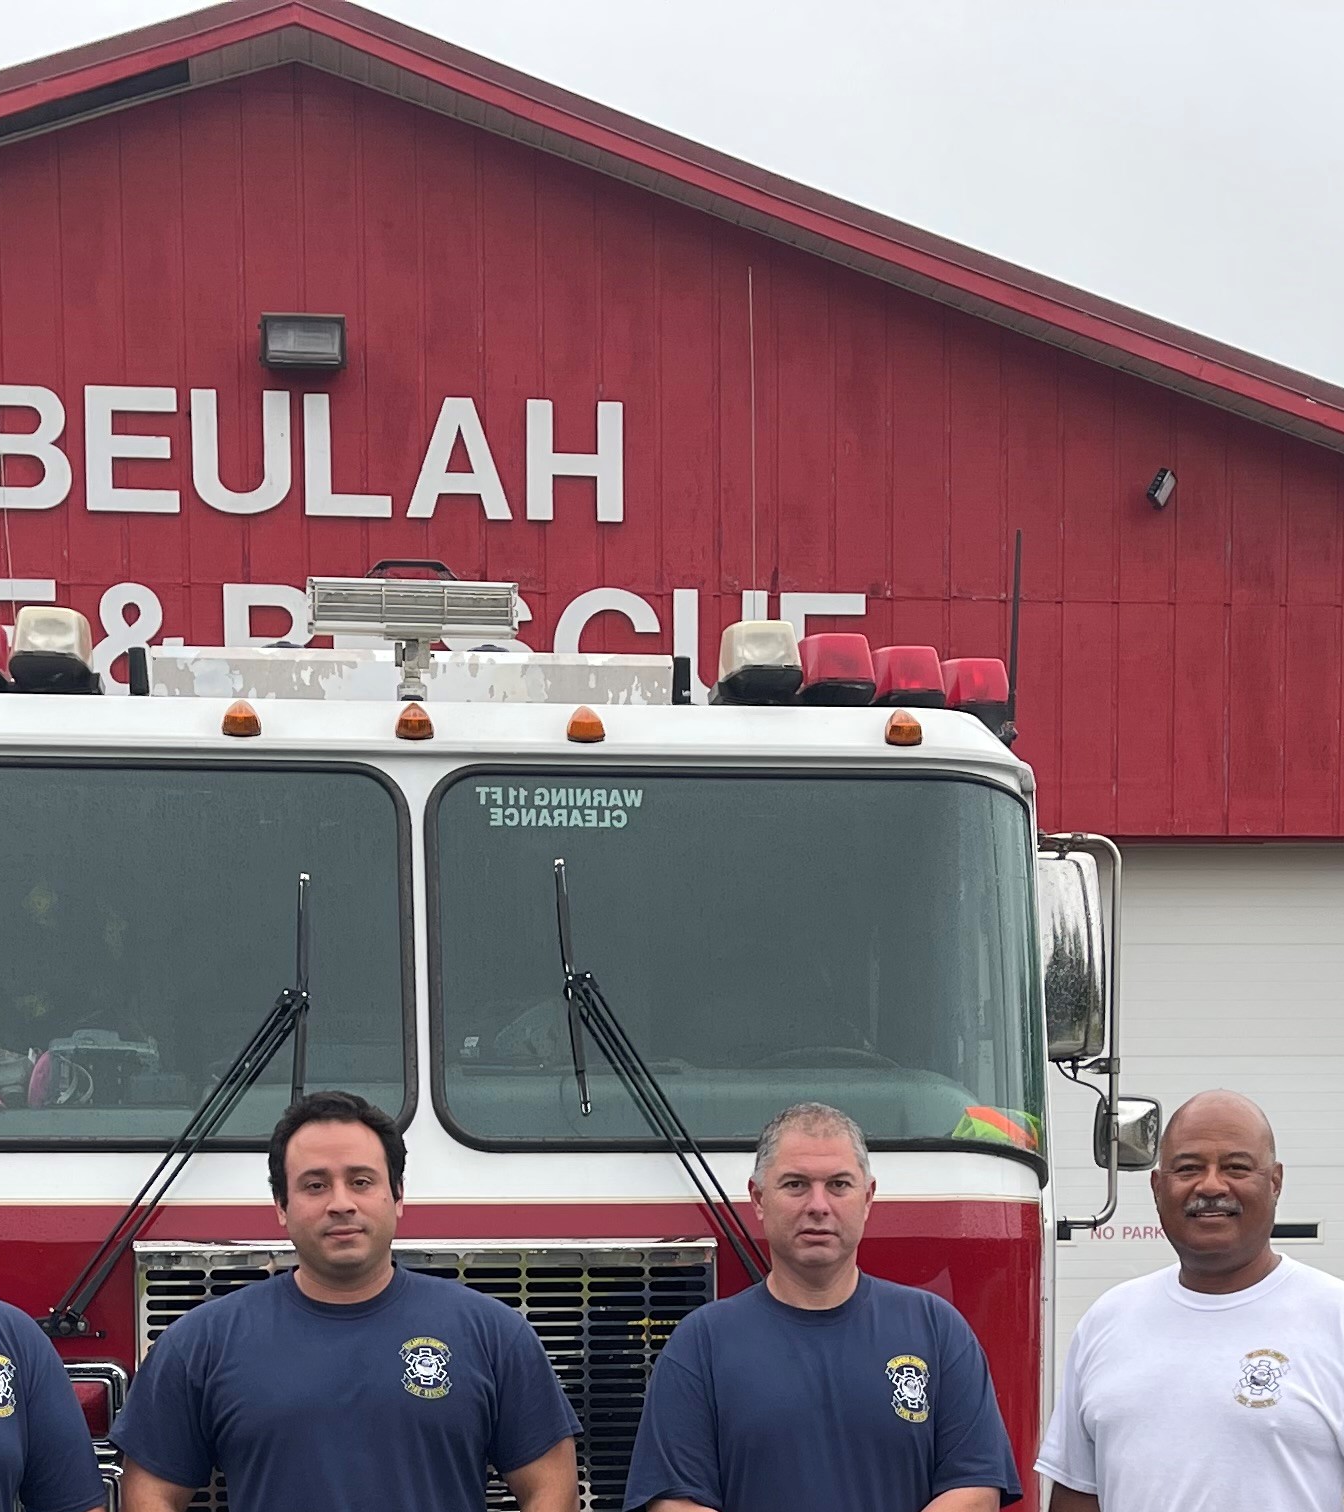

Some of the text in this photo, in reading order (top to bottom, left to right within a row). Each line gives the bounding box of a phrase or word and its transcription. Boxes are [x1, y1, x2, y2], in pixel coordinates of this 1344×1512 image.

[92, 582, 185, 696] &
[222, 583, 867, 705] RCU
[1090, 1226, 1166, 1240] NO PARK
